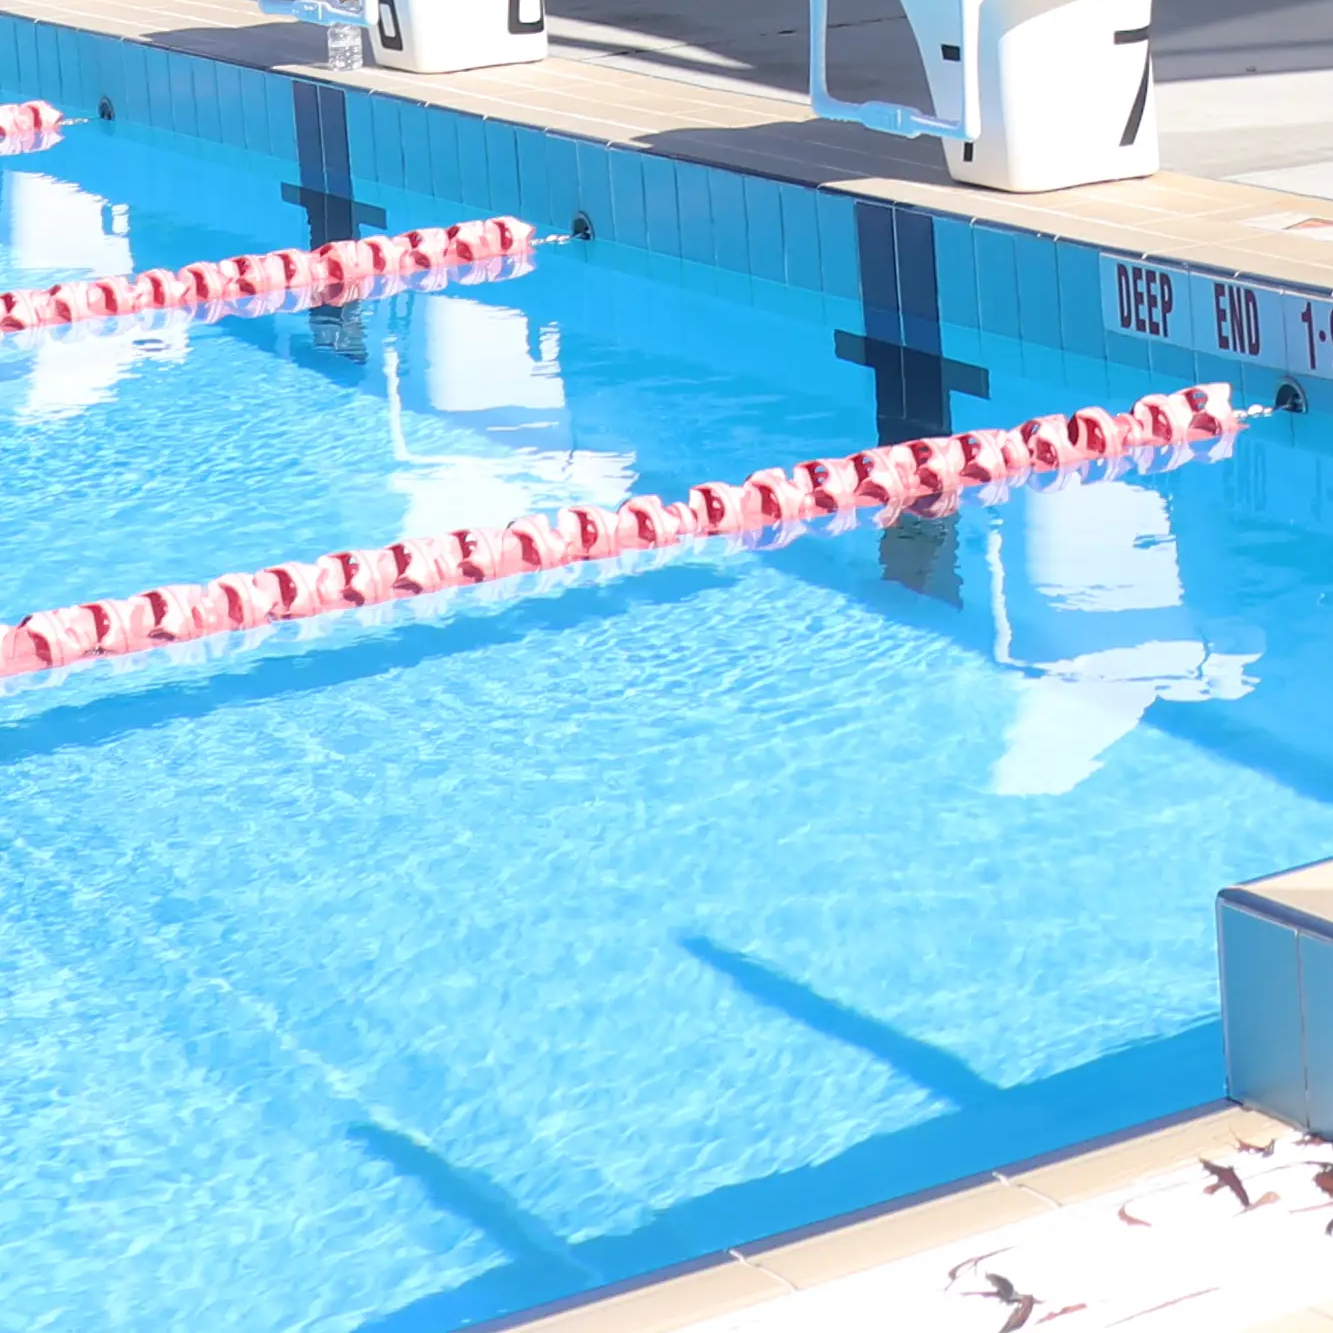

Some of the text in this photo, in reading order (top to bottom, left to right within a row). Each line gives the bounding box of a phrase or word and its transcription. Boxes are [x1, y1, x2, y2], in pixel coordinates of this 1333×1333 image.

[1113, 24, 1151, 147] 7
[1116, 263, 1174, 337] DEEP
[1214, 282, 1261, 358] END
